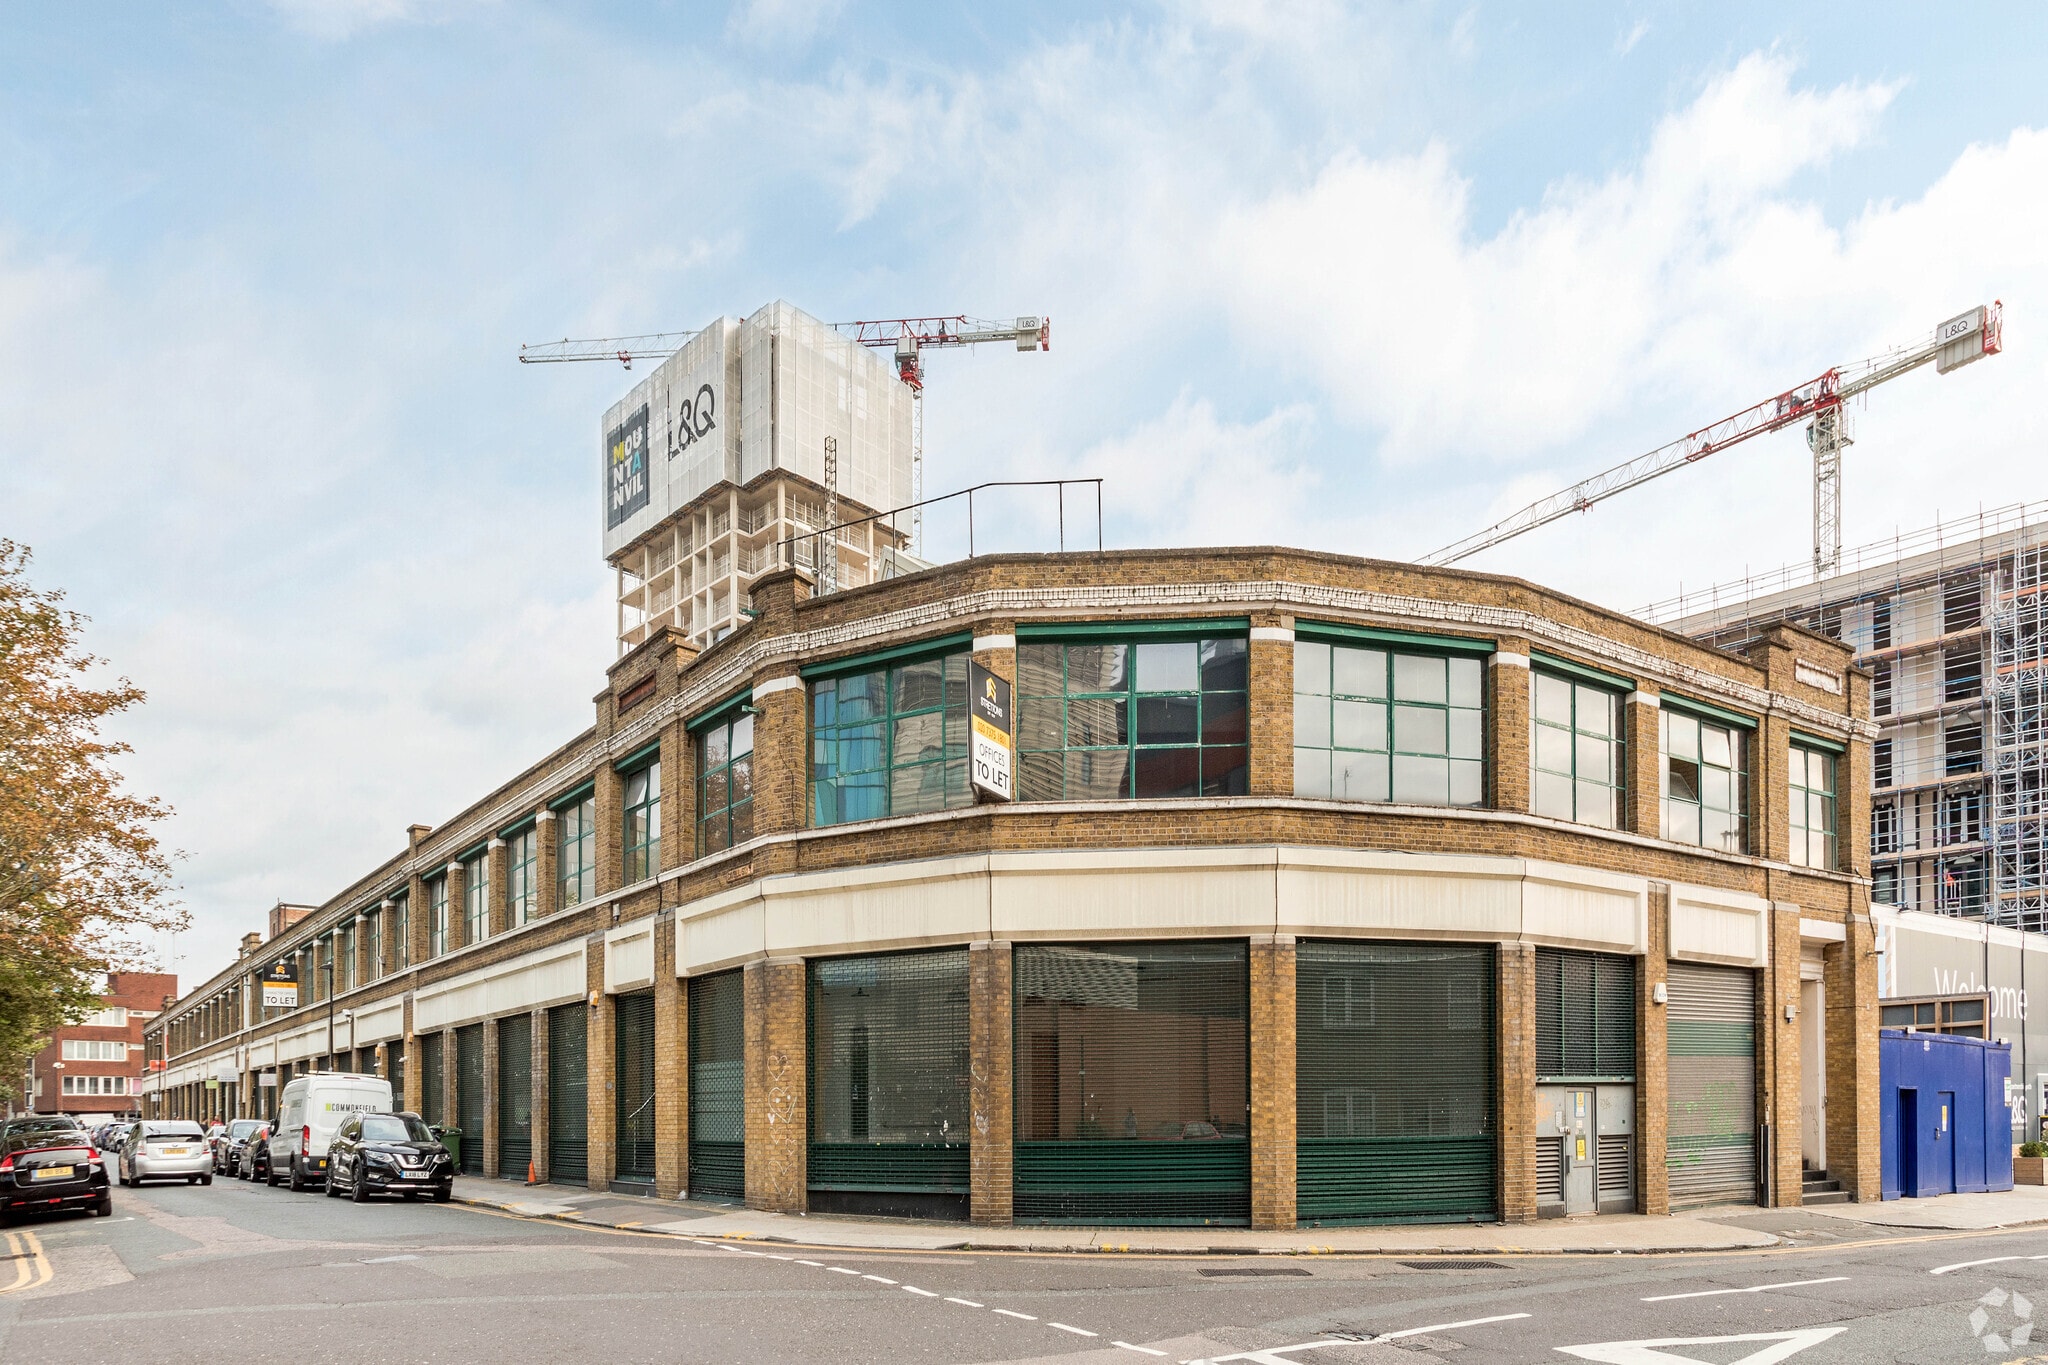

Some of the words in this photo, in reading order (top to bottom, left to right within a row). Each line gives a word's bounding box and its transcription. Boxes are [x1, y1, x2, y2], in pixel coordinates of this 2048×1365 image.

[1945, 320, 1968, 339] L&Q
[668, 384, 716, 462] L&Q
[613, 426, 643, 465] MOU
[613, 450, 642, 488] NTA
[613, 472, 644, 511] NVIL
[979, 743, 1006, 767] OFFICES
[976, 759, 990, 780] TO
[992, 767, 1009, 790] LET
[265, 996, 278, 1004] TO
[280, 997, 295, 1005] LET
[1934, 966, 2028, 1021] Wlome
[332, 1103, 377, 1112] COMMONFIELD
